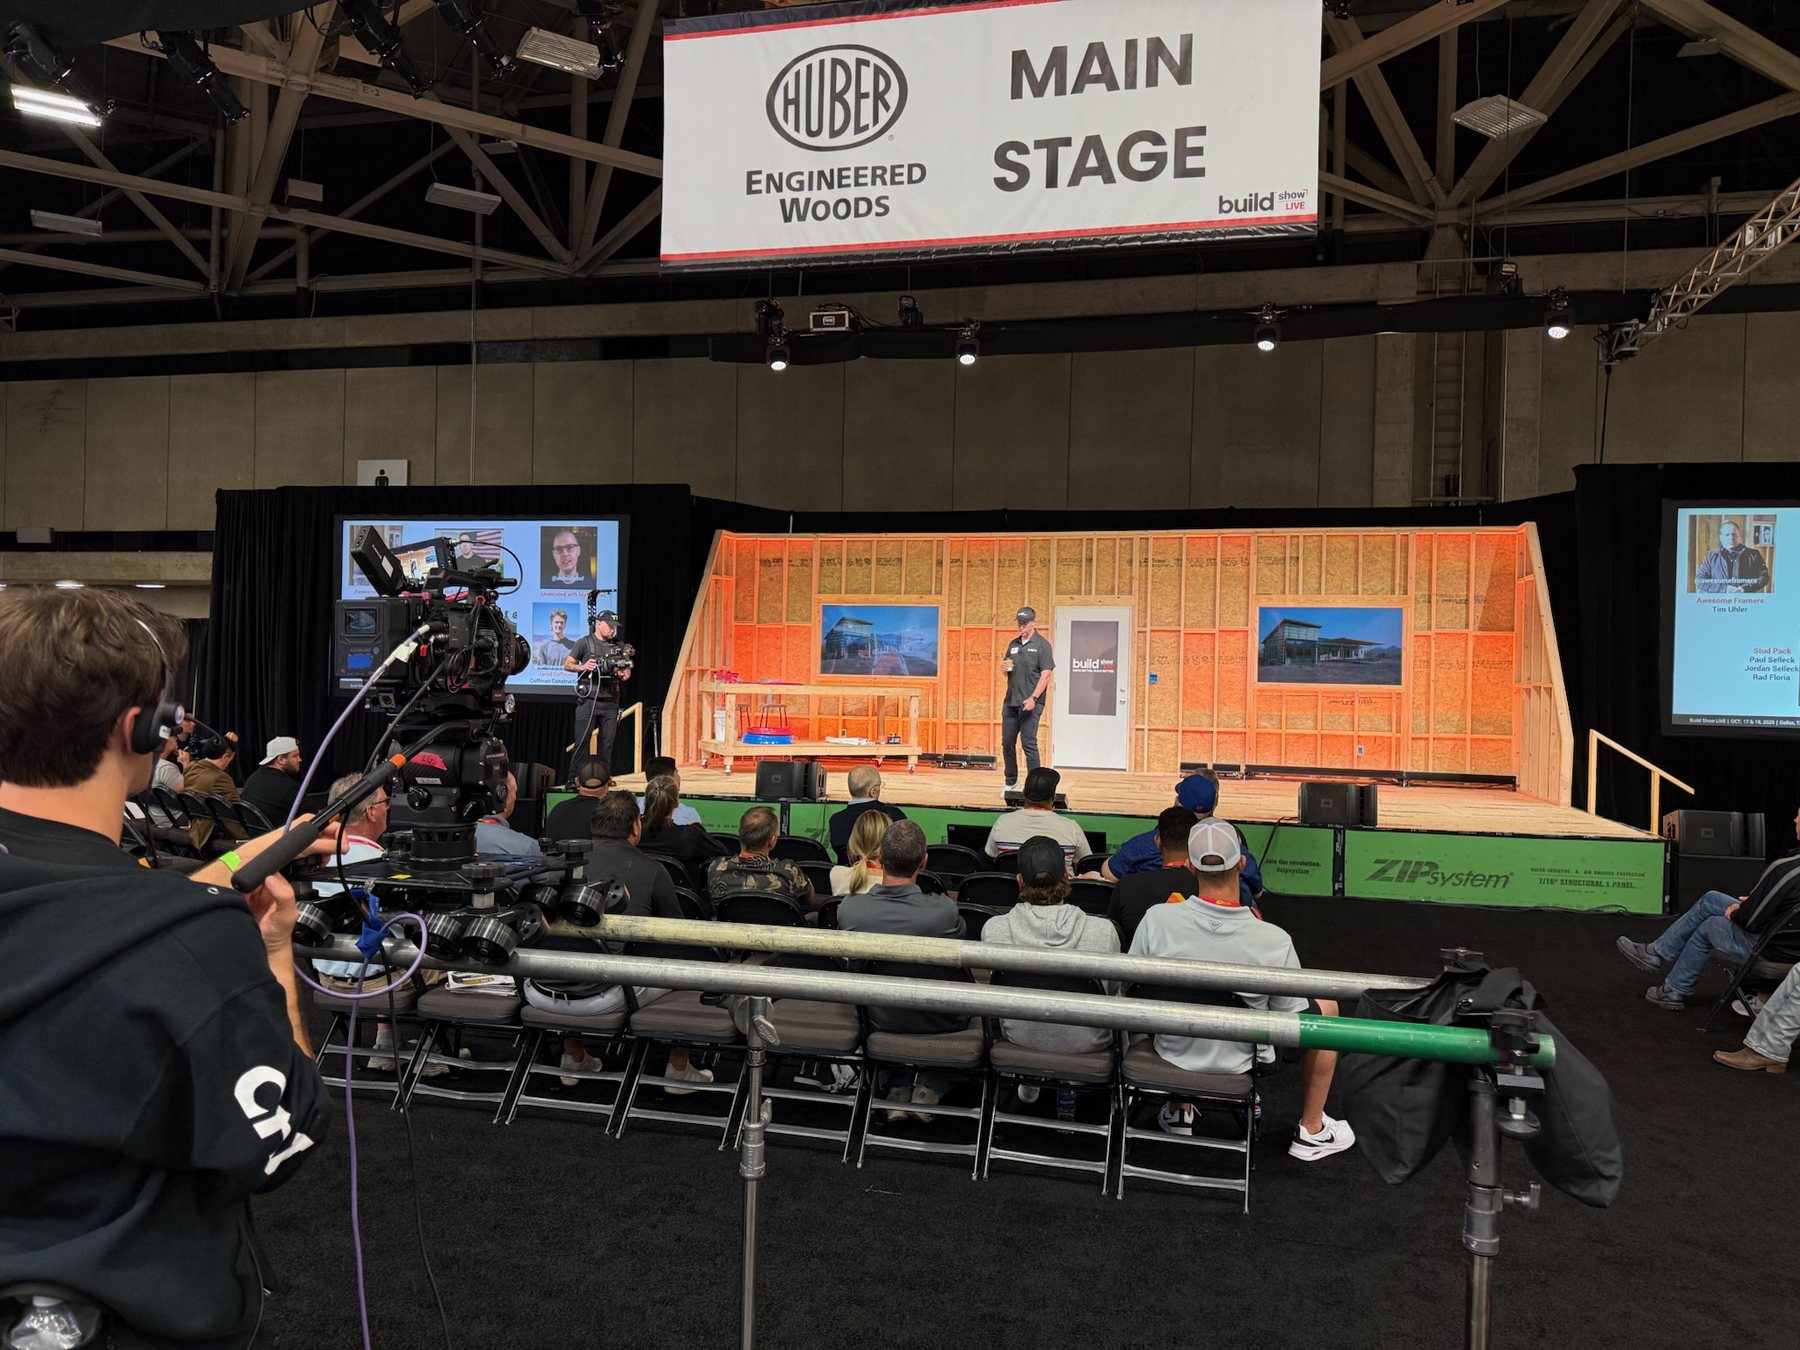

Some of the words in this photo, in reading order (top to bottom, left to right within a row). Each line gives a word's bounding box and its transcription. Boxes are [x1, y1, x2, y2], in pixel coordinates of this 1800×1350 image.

[1010, 33, 1193, 100] MAIN
[783, 57, 892, 139] HUBER
[993, 126, 1207, 192] STAGE
[746, 163, 927, 195] ENGINEERED
[779, 195, 890, 223] WOODS
[1218, 192, 1275, 214] build
[1278, 190, 1305, 200] show
[1285, 202, 1305, 210] LIVE
[1072, 658, 1099, 668] build
